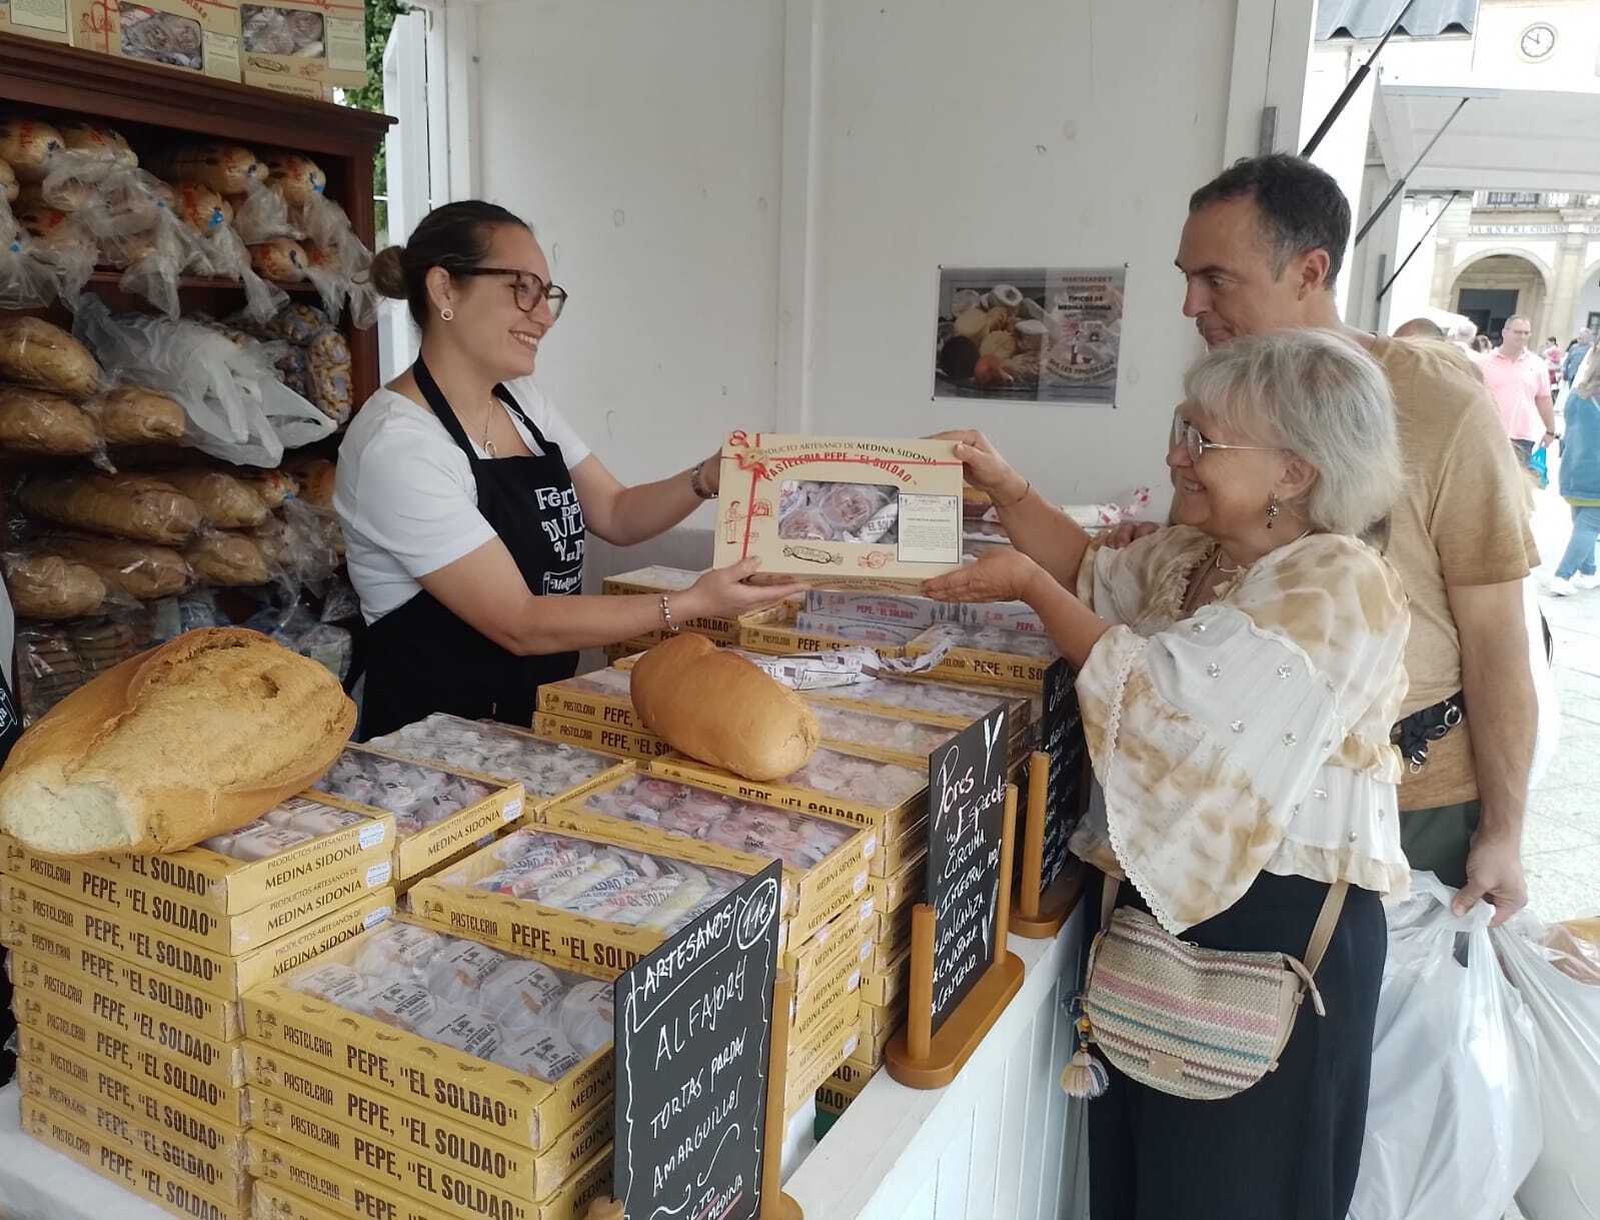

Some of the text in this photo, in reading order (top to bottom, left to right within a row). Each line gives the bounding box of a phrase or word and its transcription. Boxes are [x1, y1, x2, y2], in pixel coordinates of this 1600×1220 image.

[856, 442, 895, 456] MEDINA
[896, 449, 938, 466] SIDONIA
[798, 638, 820, 652] PEPE
[601, 730, 631, 751] PEPE,
[603, 706, 633, 728] PEPE,
[427, 829, 464, 857] MEDINA
[464, 809, 501, 837] SIDONIA
[30, 857, 217, 936] PASTELERIA PEPE, "EL SOLDAO"
[151, 856, 216, 897] SOLDAO"
[265, 843, 364, 891] MEDINA SIDONIA
[267, 879, 363, 932] MEDINA SIDONIA
[32, 900, 222, 981] PASTELERIA PEPE, "EL SOLDAO"
[272, 922, 366, 978] MEDINA SIDONIA
[450, 911, 648, 972] PASTELERIA PEPE, "EL SOLD
[81, 950, 119, 987] PEPE,
[122, 967, 145, 996] "EL
[149, 978, 212, 1020] SOLDAO"
[43, 974, 220, 1067] PASTELERIA PEPE, "EL SOLDAO"
[96, 1031, 133, 1070] PEPE,
[137, 1050, 160, 1080] "EL
[163, 1061, 226, 1106] SOLDAO"
[283, 1024, 518, 1127] PASTELERIA PEPE, "EL SOLDAO"
[98, 1072, 135, 1113] PEPE,
[138, 1093, 161, 1123] "EL
[162, 1104, 225, 1151] SOLDAO"
[283, 1072, 517, 1179] PASTELERIA PEPE, "EL SOLDAO"
[650, 1067, 705, 1139] TORTAS
[97, 1107, 134, 1146] PEPE,
[162, 1139, 223, 1186] SOLDAO"
[100, 1145, 137, 1187] PEPE,
[141, 1168, 163, 1200] "EL
[290, 1114, 340, 1150] PASTELERIA
[354, 1137, 402, 1181] PEPE,
[407, 1161, 437, 1195] "EL
[289, 1165, 398, 1220] PASTELERIA PEPE
